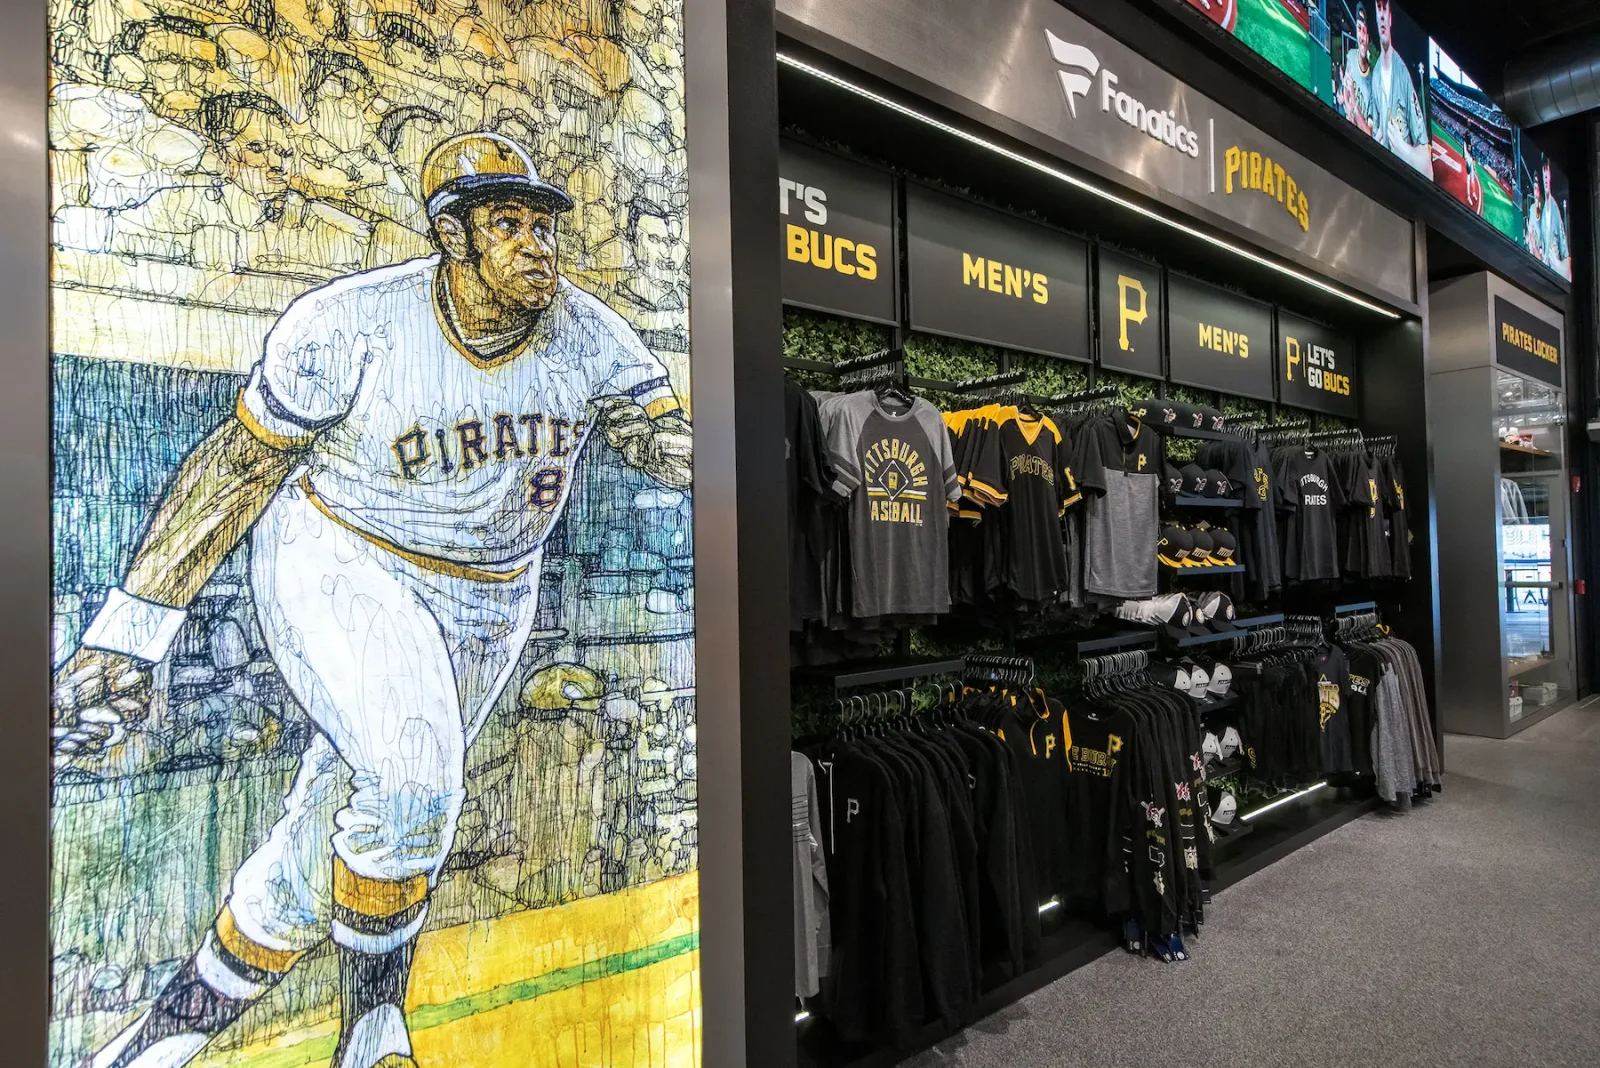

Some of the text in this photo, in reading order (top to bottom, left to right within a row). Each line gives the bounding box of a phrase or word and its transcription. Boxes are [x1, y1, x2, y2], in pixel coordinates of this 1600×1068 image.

[1100, 68, 1200, 159] Fanatics
[779, 177, 828, 226] T'S
[1224, 145, 1310, 232] PIRATES
[786, 223, 878, 281] BUCS
[962, 252, 1049, 305] MEN'S
[1117, 274, 1148, 352] P
[1198, 322, 1249, 359] MEN'S
[1285, 336, 1301, 381] P
[1307, 342, 1335, 370] LET'S
[1502, 322, 1558, 364] PIRATES LOCKER
[1308, 367, 1350, 396] GO BUCS
[391, 411, 586, 480] PIRATES
[528, 467, 565, 512] 8
[1045, 732, 1057, 760] P
[1107, 733, 1124, 756] P
[847, 797, 861, 824] P
